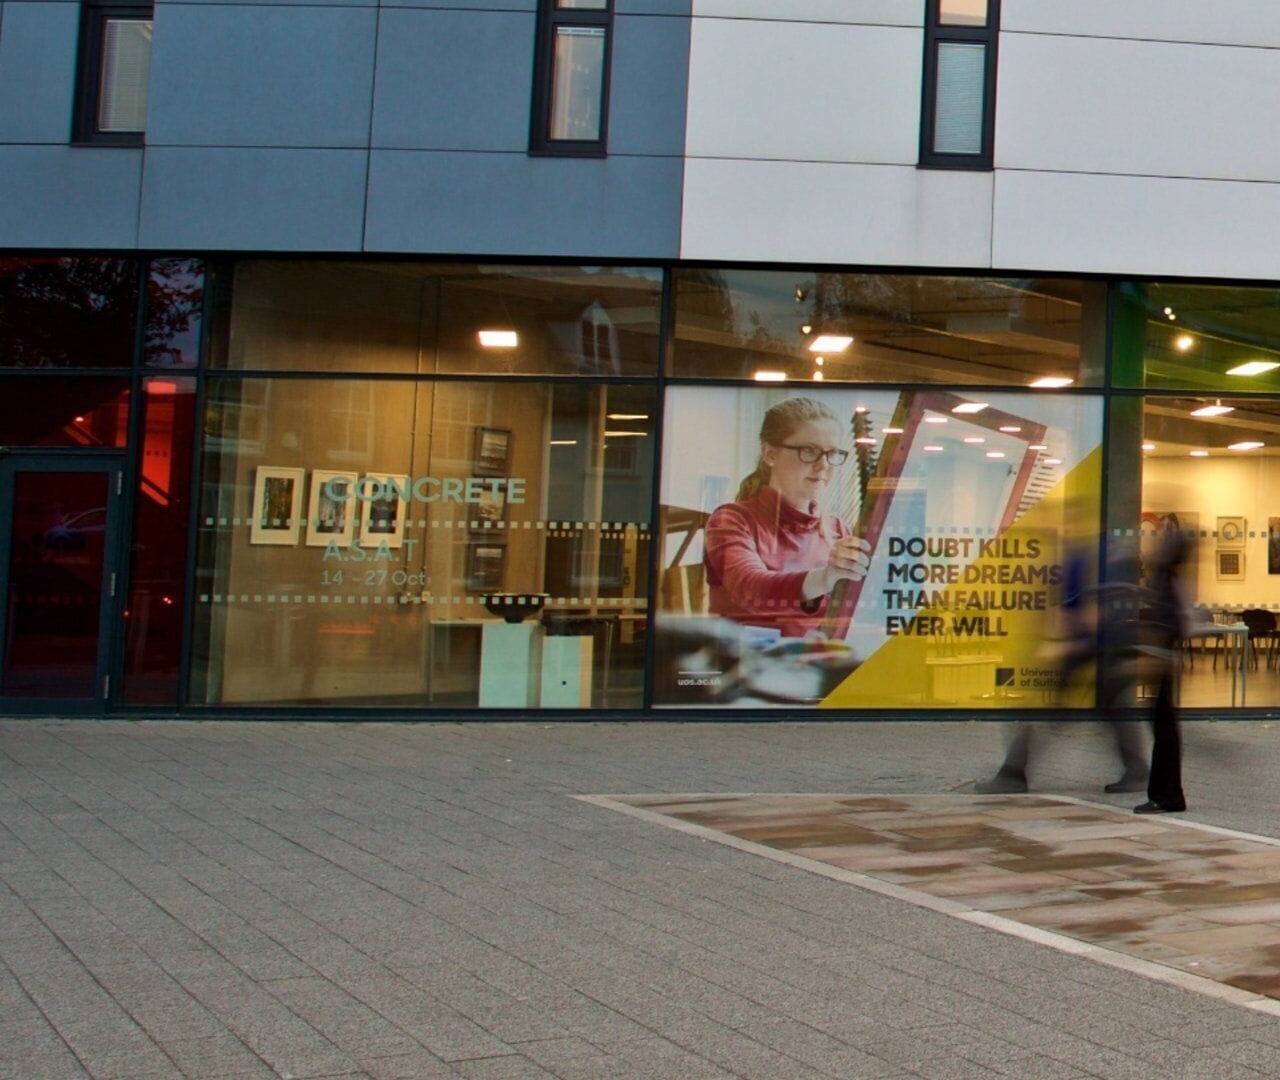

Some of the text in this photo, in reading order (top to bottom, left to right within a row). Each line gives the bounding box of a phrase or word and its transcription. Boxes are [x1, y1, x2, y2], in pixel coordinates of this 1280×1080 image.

[324, 475, 526, 504] CONCRETE
[888, 536, 1041, 559] DOUBT KILLS
[320, 571, 344, 585] 14
[364, 571, 387, 585] 27
[392, 570, 426, 586] Oct
[887, 563, 1064, 585] MORE DREAMS
[883, 589, 1047, 611] THAN FAILURE
[886, 616, 1008, 637] EVER WILL
[1020, 667, 1067, 678] Univers
